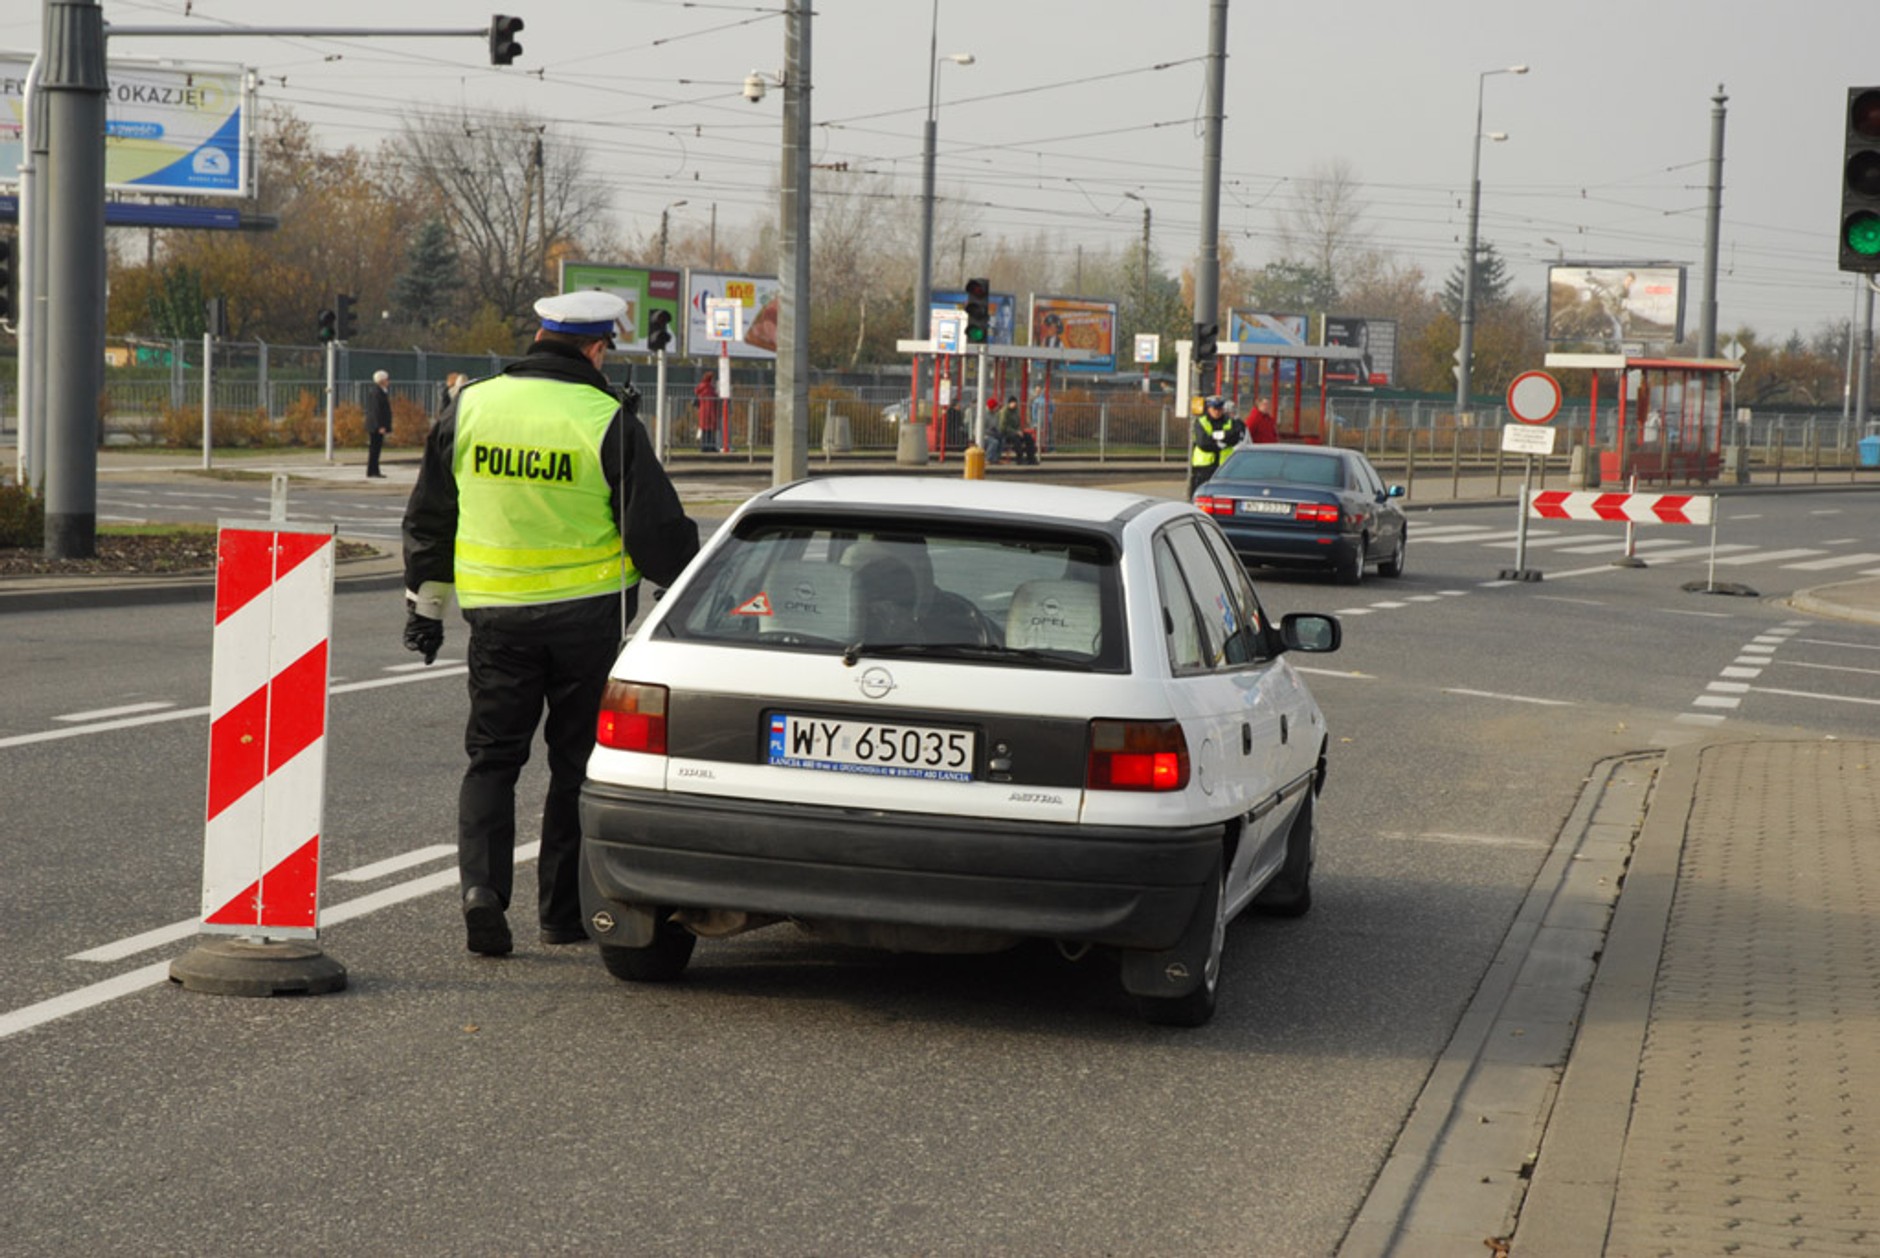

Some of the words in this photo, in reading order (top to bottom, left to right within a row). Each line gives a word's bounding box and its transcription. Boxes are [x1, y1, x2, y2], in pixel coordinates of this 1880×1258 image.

[117, 84, 205, 109] OKAZJĘ!
[475, 445, 573, 482] POLICJA
[784, 601, 821, 615] OPEL
[1031, 617, 1069, 628] OPEL
[770, 740, 783, 750] PL
[793, 720, 841, 757] WY
[855, 727, 966, 767] 65035
[770, 756, 801, 768] LANCIA
[939, 769, 971, 782] LANCIA
[1008, 792, 1063, 804] ASTRA
